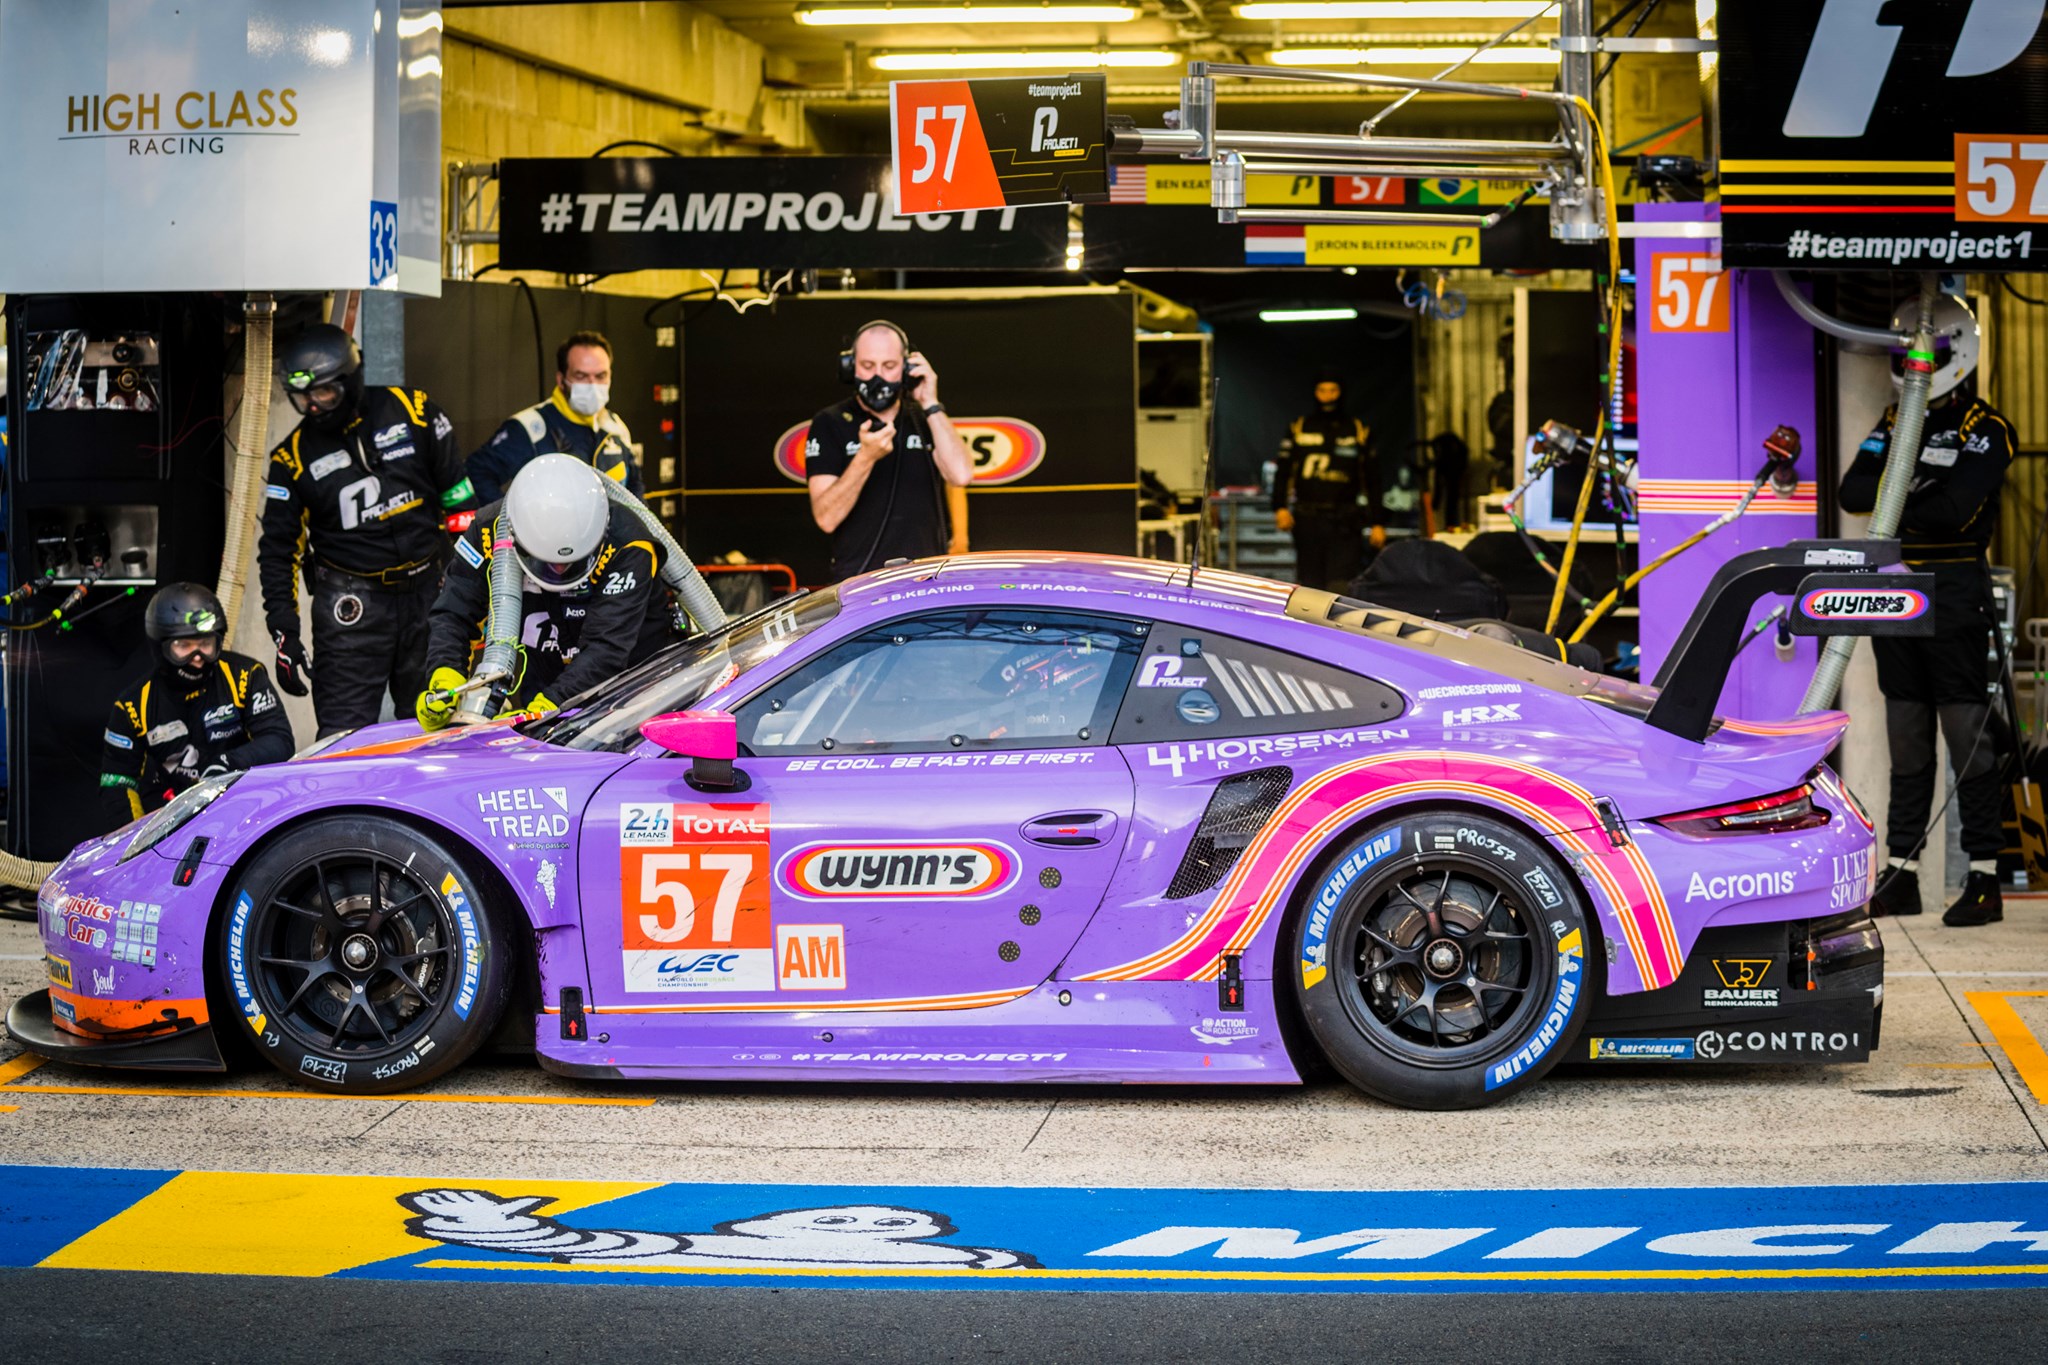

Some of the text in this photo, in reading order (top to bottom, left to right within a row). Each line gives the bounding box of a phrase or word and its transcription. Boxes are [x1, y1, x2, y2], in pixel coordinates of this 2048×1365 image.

[1028, 82, 1082, 100] #teamproject1
[68, 88, 299, 133] HIGH CLASS
[129, 136, 225, 156] RACING
[912, 104, 967, 184] 57
[1155, 180, 1211, 190] BEN KEAT
[372, 210, 397, 280] 33
[1314, 239, 1448, 250] JEROEN BLEEKEMOLEN
[1788, 231, 2032, 264] #teamproject1
[1657, 252, 1728, 329] 57
[890, 584, 975, 602] B.KEATING
[1020, 583, 1089, 593] F.FRAGA
[1155, 676, 1208, 689] PROJECT
[1443, 703, 1521, 723] HRX
[786, 752, 1096, 771] BE COOL. BE FAST. BE FIRST.
[477, 787, 544, 813] HEEL
[482, 814, 570, 838] TREAD
[625, 807, 669, 831] 24h
[676, 814, 765, 834] TOTAL
[536, 842, 544, 852] by
[546, 842, 570, 852] passion
[1832, 848, 1867, 884] LUKE
[1309, 834, 1392, 940] MICHELIN
[1684, 870, 1797, 903] Acronis
[1830, 876, 1867, 909] SPORT
[639, 853, 753, 943] 57
[68, 914, 107, 949] Care
[1550, 919, 1568, 939] RL
[230, 899, 250, 999] MICHELIN
[782, 936, 841, 979] AM
[457, 911, 478, 1011] MICHELIN
[658, 954, 740, 974] WEC
[93, 965, 116, 996] Soul
[1704, 989, 1778, 999] BAUER
[1215, 1018, 1247, 1028] ACTION
[1233, 1027, 1259, 1035] SAFETY
[1494, 978, 1577, 1083] MICHELIN
[265, 1031, 280, 1047] FL
[1619, 1043, 1686, 1055] MICHELIN
[792, 1052, 1068, 1062] #TEAMPROJECT1
